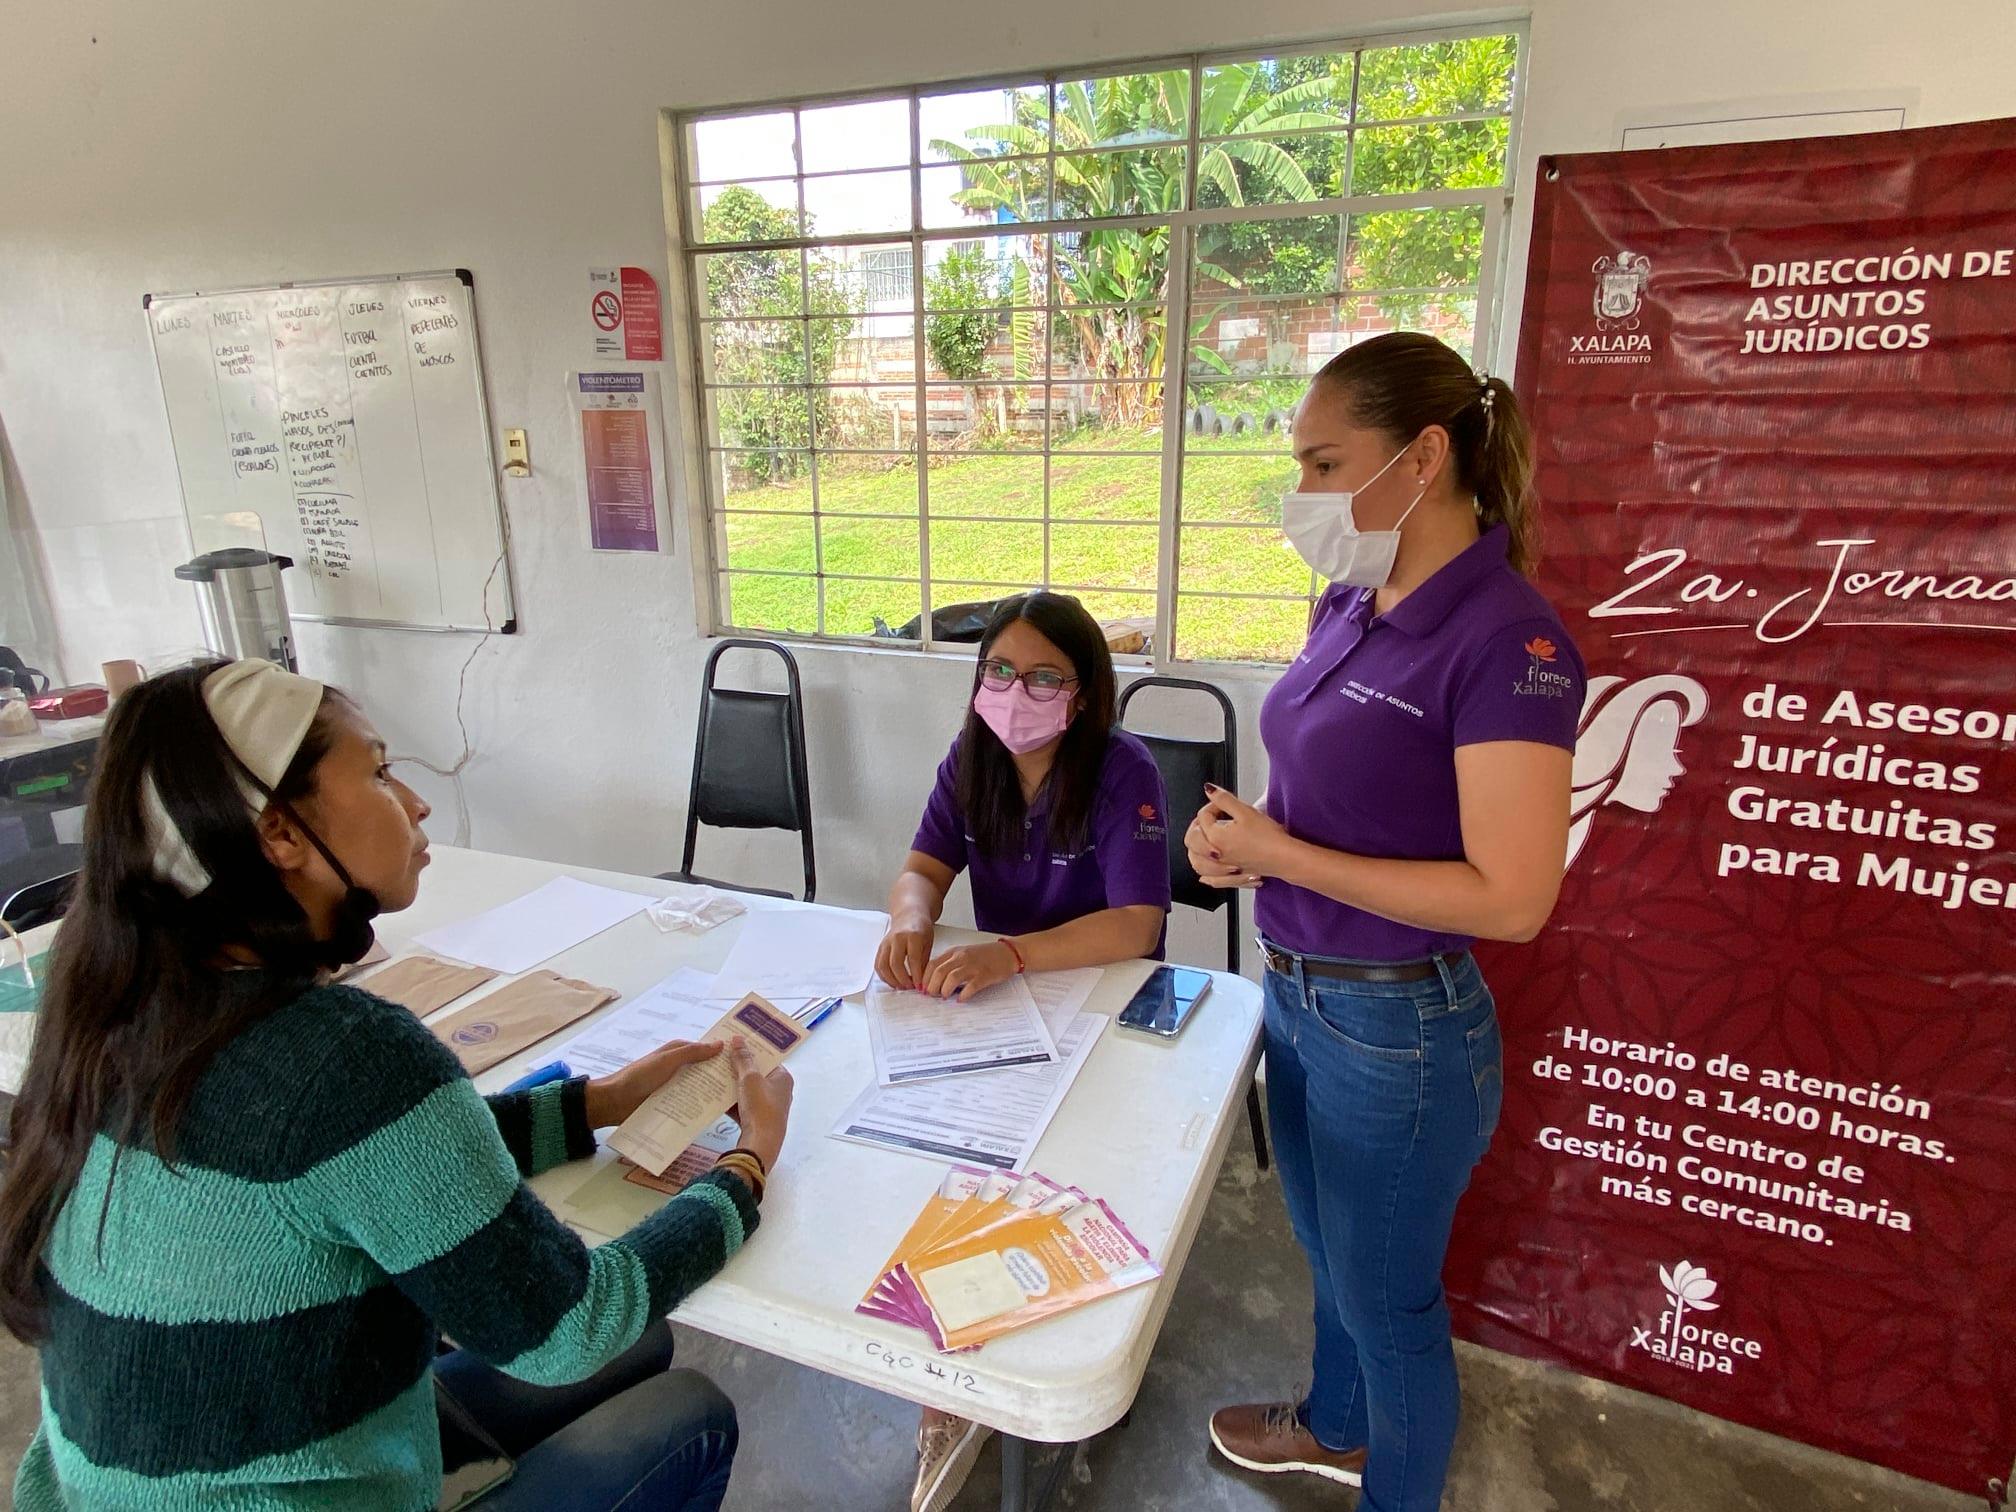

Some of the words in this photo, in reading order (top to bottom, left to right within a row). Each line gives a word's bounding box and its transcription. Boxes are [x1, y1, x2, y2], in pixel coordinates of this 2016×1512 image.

[1750, 247, 1953, 289] DIRECCIÓN
[1961, 249, 2015, 278] DE
[213, 309, 252, 326] MARTES
[348, 301, 384, 316] JUEVES
[408, 295, 447, 309] VIERNES
[1744, 289, 1927, 322] ASUNTOS
[157, 317, 191, 334] LUNES
[1569, 335, 1652, 352] XALAPA
[1740, 320, 1933, 355] JURÍDICOS
[1579, 355, 1652, 365] AYUNTAMIENTO
[1512, 680, 1563, 699] Xalapa
[1527, 665, 1572, 689] florece
[1385, 695, 1424, 718] ASUNTOS
[1741, 683, 1808, 722] de
[1821, 690, 2016, 742] Asesor
[1732, 735, 1982, 794] Jurídicas
[1727, 786, 1997, 851] Gratuitas
[1717, 842, 1841, 884] para
[1562, 1025, 1697, 1071] Horario
[1705, 1053, 1751, 1082] de
[1758, 1067, 1932, 1120] atención
[1531, 1056, 1573, 1082] de
[1580, 1064, 1677, 1101] 10:00
[1684, 1086, 1707, 1108] a
[1716, 1090, 1821, 1130] 14:00
[1828, 1112, 1956, 1164] horas.
[1586, 1104, 1626, 1132] En
[1635, 1115, 1673, 1141] tu
[1681, 1123, 1807, 1171] Centro
[1816, 1154, 1866, 1185] de
[1538, 1126, 1668, 1174] Gestión
[1676, 1156, 1913, 1232] Comunitaria
[1600, 1174, 1672, 1207] más
[1680, 1194, 1835, 1246] cercano.
[1630, 1325, 1733, 1375] Xalapa
[1658, 1310, 1762, 1359] florece
